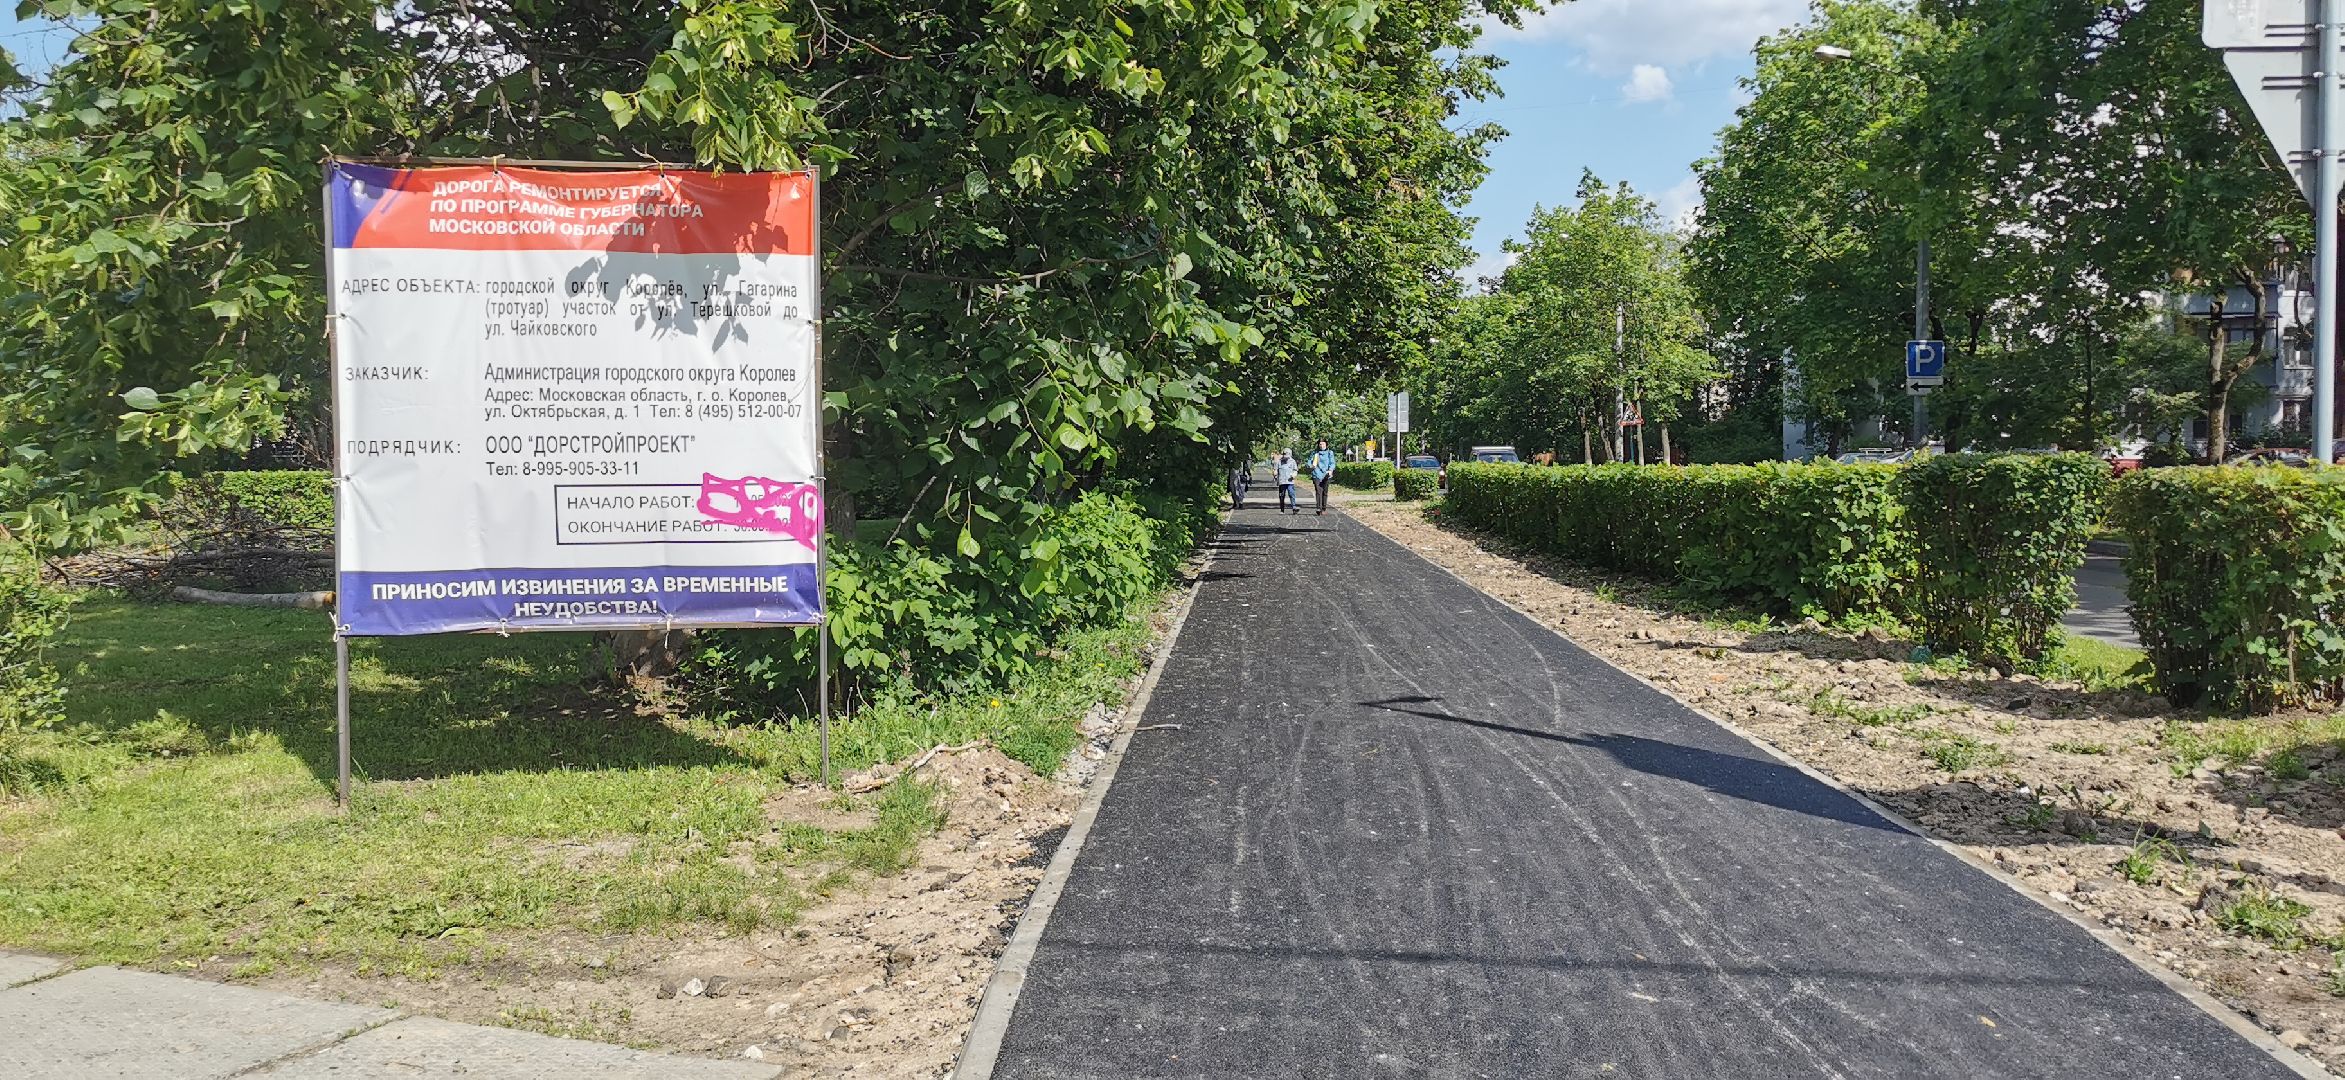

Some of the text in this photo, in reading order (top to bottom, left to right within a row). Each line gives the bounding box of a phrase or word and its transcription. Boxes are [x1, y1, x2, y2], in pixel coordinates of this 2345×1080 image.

[432, 178, 662, 201] ДОРОГА РЕМОНТИРУЕТСЯ
[430, 199, 704, 219] ПО ПРОГРАММЕ ГУБЕРНАТОРА
[429, 217, 645, 236] МОСКОВСКОЙ ОБЛАСТИ
[341, 278, 480, 295] АДРЕС ОБЪЕКТА:
[485, 277, 798, 299] городской округ Королёв, ул. Гагарина
[485, 298, 798, 320] (тротуар) участок от ул. Терешковой до
[485, 319, 597, 340] ул. Чайковского
[1915, 345, 1935, 372] P
[345, 366, 429, 381] ЗАКАЗЧИК:
[484, 363, 796, 386] Администрация городского округа Королев
[485, 387, 791, 404] Адрес: Московская область, г. о. Королев,
[485, 404, 802, 422] ул. Октябрьская, д. 1 Тел: 8 (495) 512-00-07
[347, 440, 461, 457] ПОДРЯДЧИК:
[485, 435, 523, 453] ООО
[486, 461, 639, 476] Тел: 8-995-905-33-11
[567, 495, 694, 509] НАЧАЛО РАБОТ:
[568, 520, 667, 533] ОКОНЧАНИЕ
[372, 575, 788, 600] ПРИНОСИМ ИЗВИНЕНИЯ ЗА ВРЕМЕННЫЕ
[514, 600, 658, 618] НЕУДОБСТВА!
